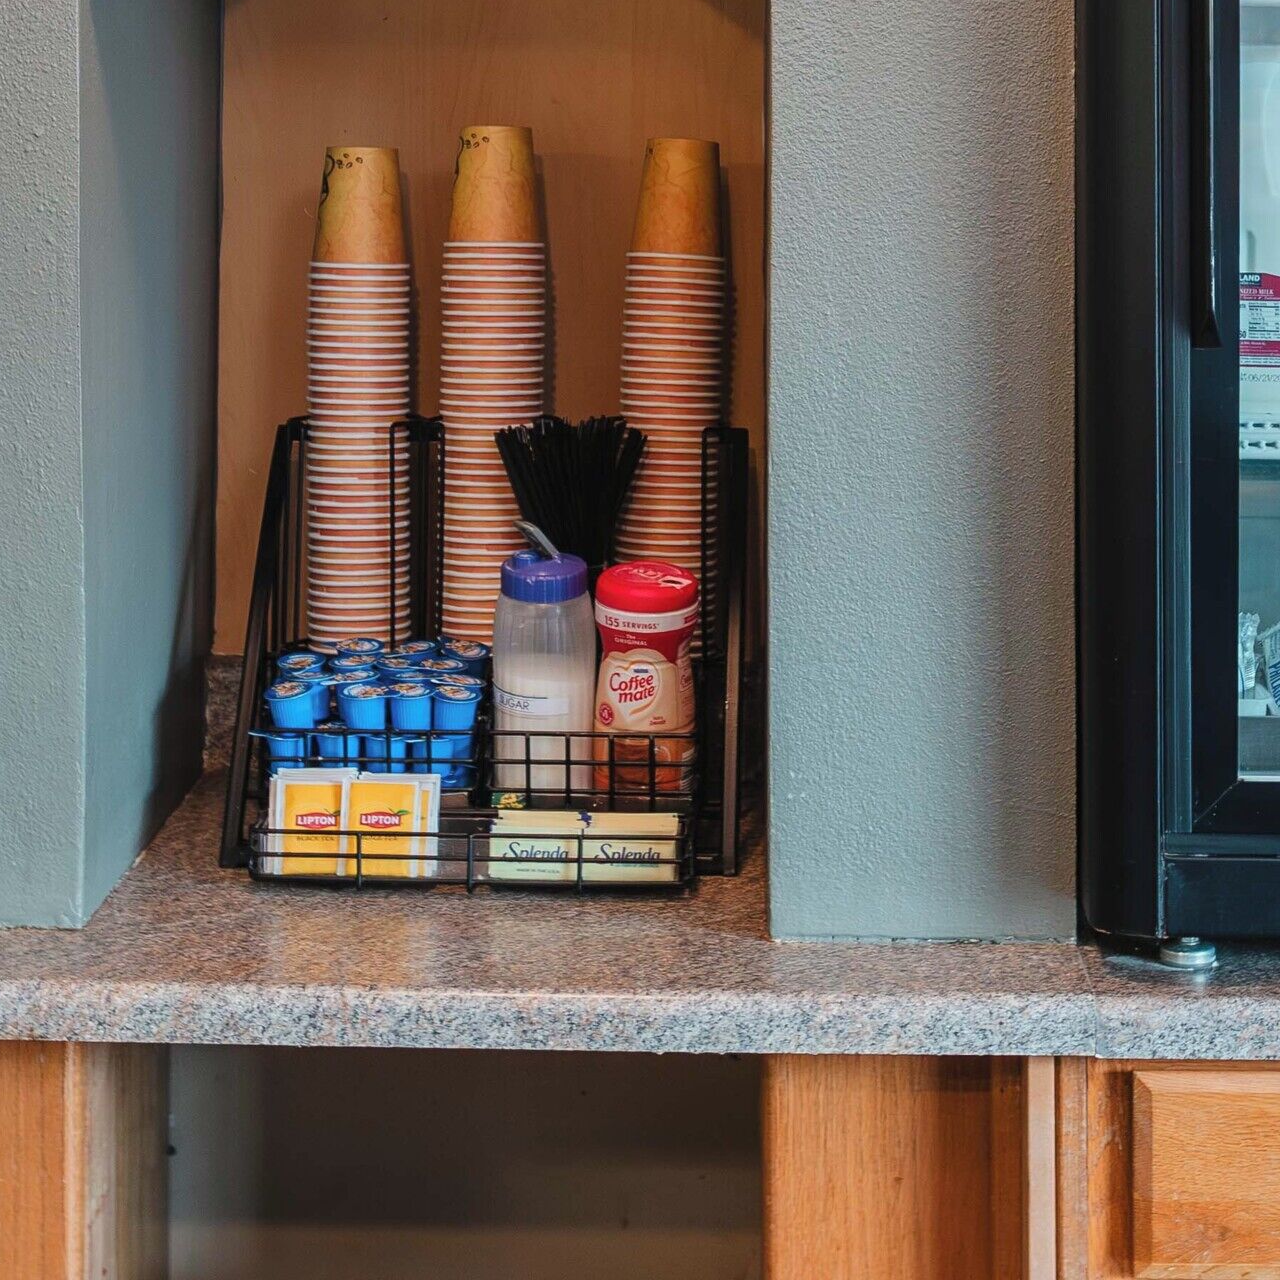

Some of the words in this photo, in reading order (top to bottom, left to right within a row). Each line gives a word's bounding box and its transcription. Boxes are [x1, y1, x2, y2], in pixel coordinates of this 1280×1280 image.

[604, 615, 620, 628] 155
[614, 637, 648, 646] ORIGINAL
[609, 672, 654, 692] Coffee
[619, 685, 655, 704] mate
[297, 815, 336, 826] LIPTON
[361, 814, 400, 825] LIPTON
[502, 842, 569, 860] Splenda
[594, 844, 661, 863] Splenda
